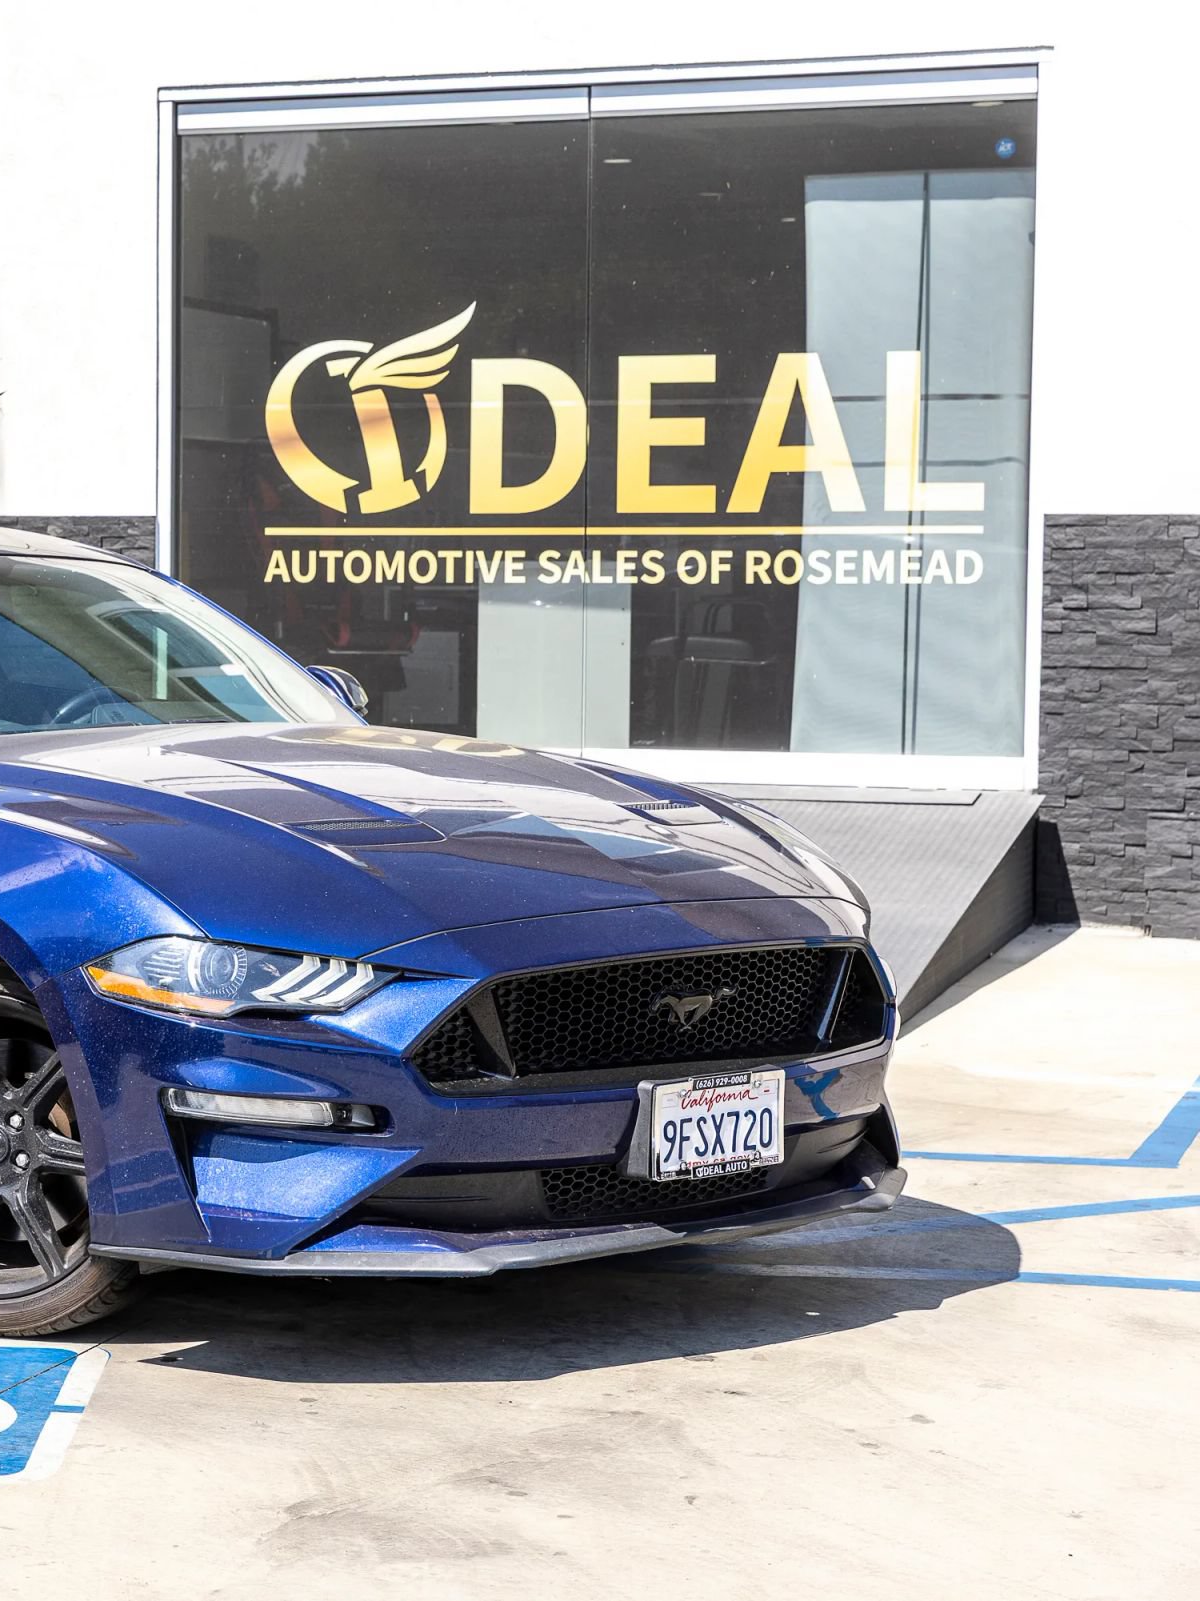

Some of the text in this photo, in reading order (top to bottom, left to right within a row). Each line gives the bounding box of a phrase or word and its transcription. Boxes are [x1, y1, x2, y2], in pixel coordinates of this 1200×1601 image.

[263, 548, 984, 584] AUTOMOTIVE SALES OF ROSEMEAD
[681, 1088, 759, 1113] California
[663, 1107, 773, 1164] 9FSX720
[725, 1161, 748, 1173] AUTO
